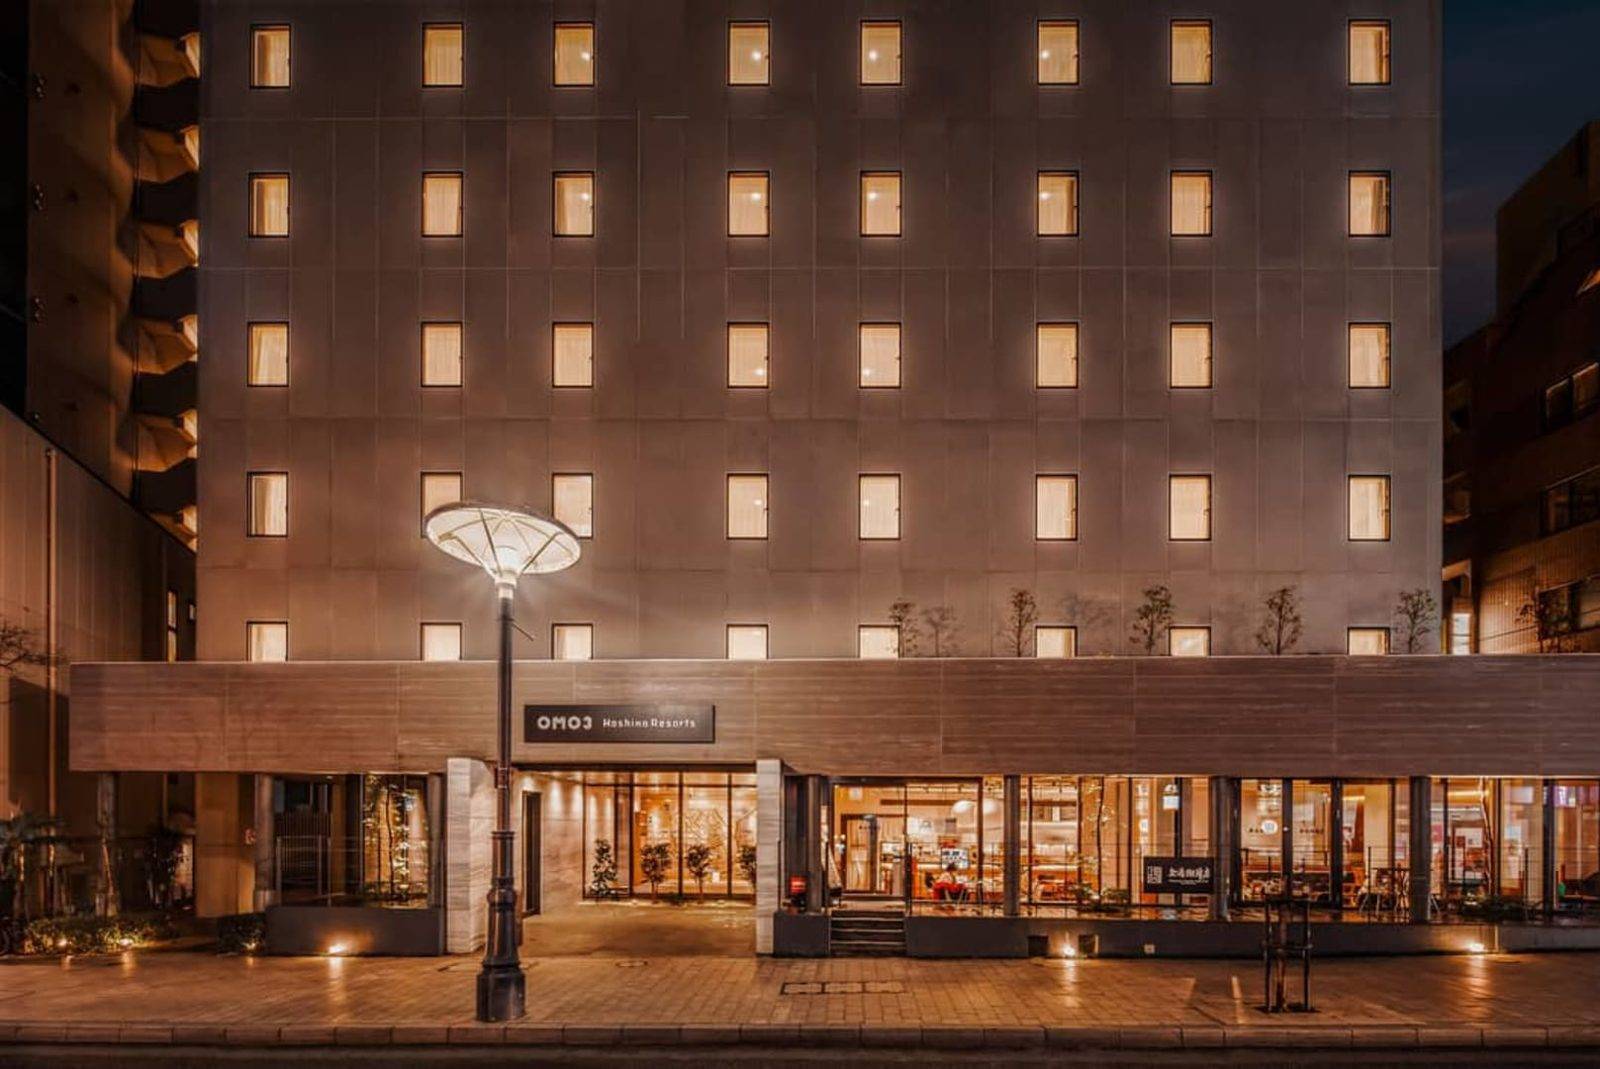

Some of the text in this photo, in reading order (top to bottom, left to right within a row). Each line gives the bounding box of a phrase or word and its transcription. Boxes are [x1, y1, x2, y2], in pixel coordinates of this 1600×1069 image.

[537, 715, 697, 730] OMO3 Hoshino Resorts
